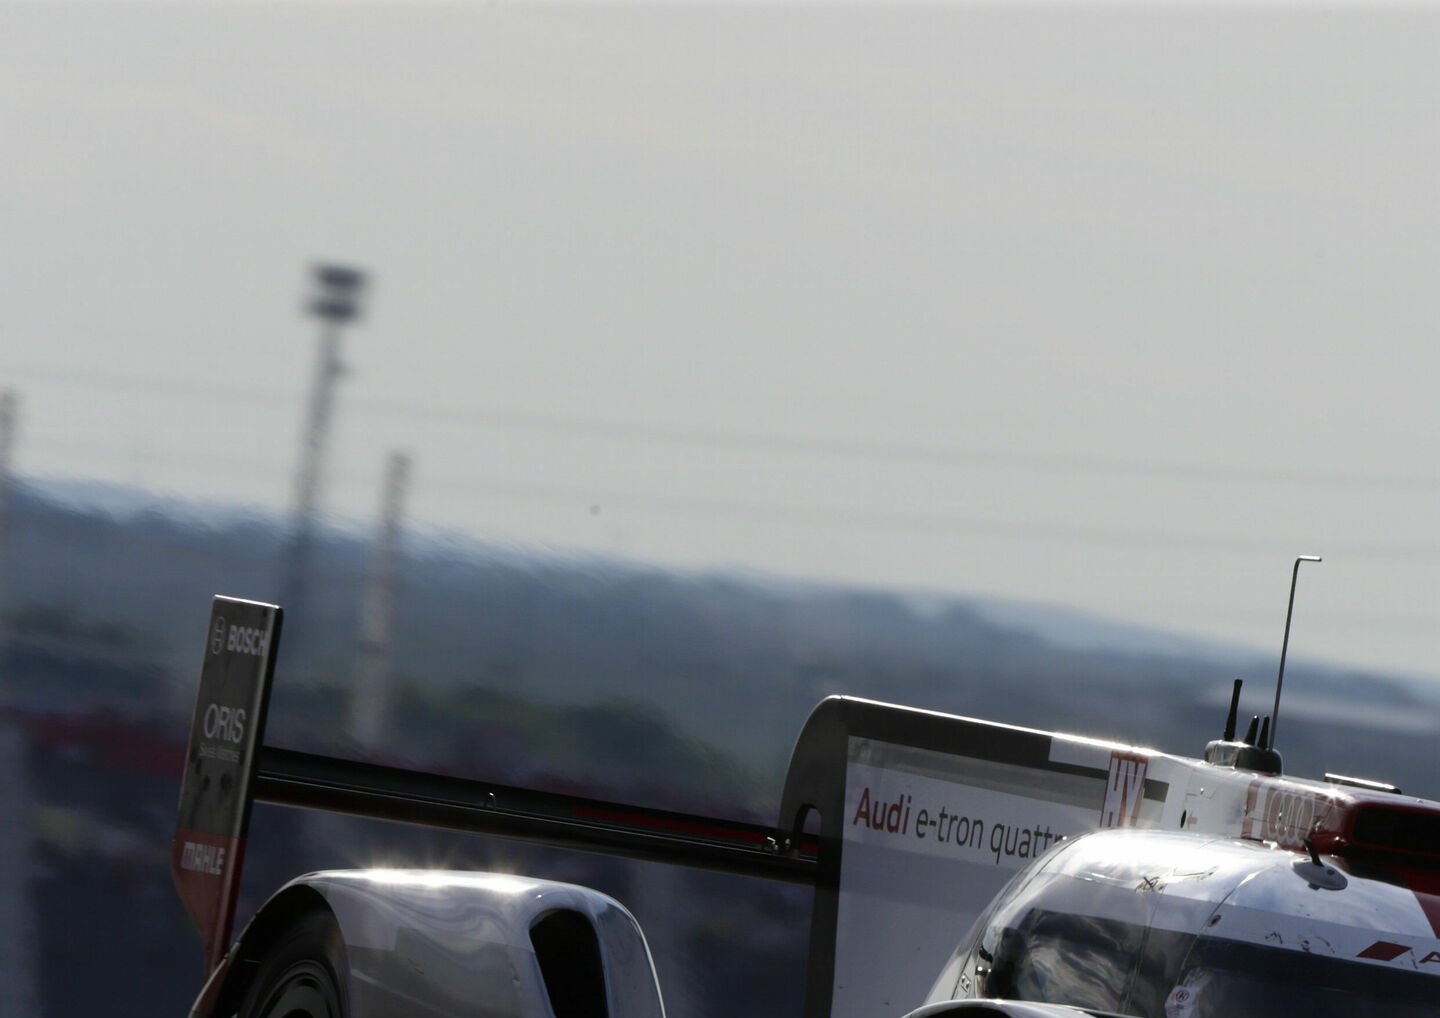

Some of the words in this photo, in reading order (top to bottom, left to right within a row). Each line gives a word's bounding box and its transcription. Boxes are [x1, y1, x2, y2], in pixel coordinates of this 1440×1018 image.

[226, 624, 267, 656] BOSCH
[204, 703, 246, 744] ORIS
[853, 787, 912, 834] Audi
[915, 806, 984, 849] e-tron
[181, 841, 226, 876] MAHLE
